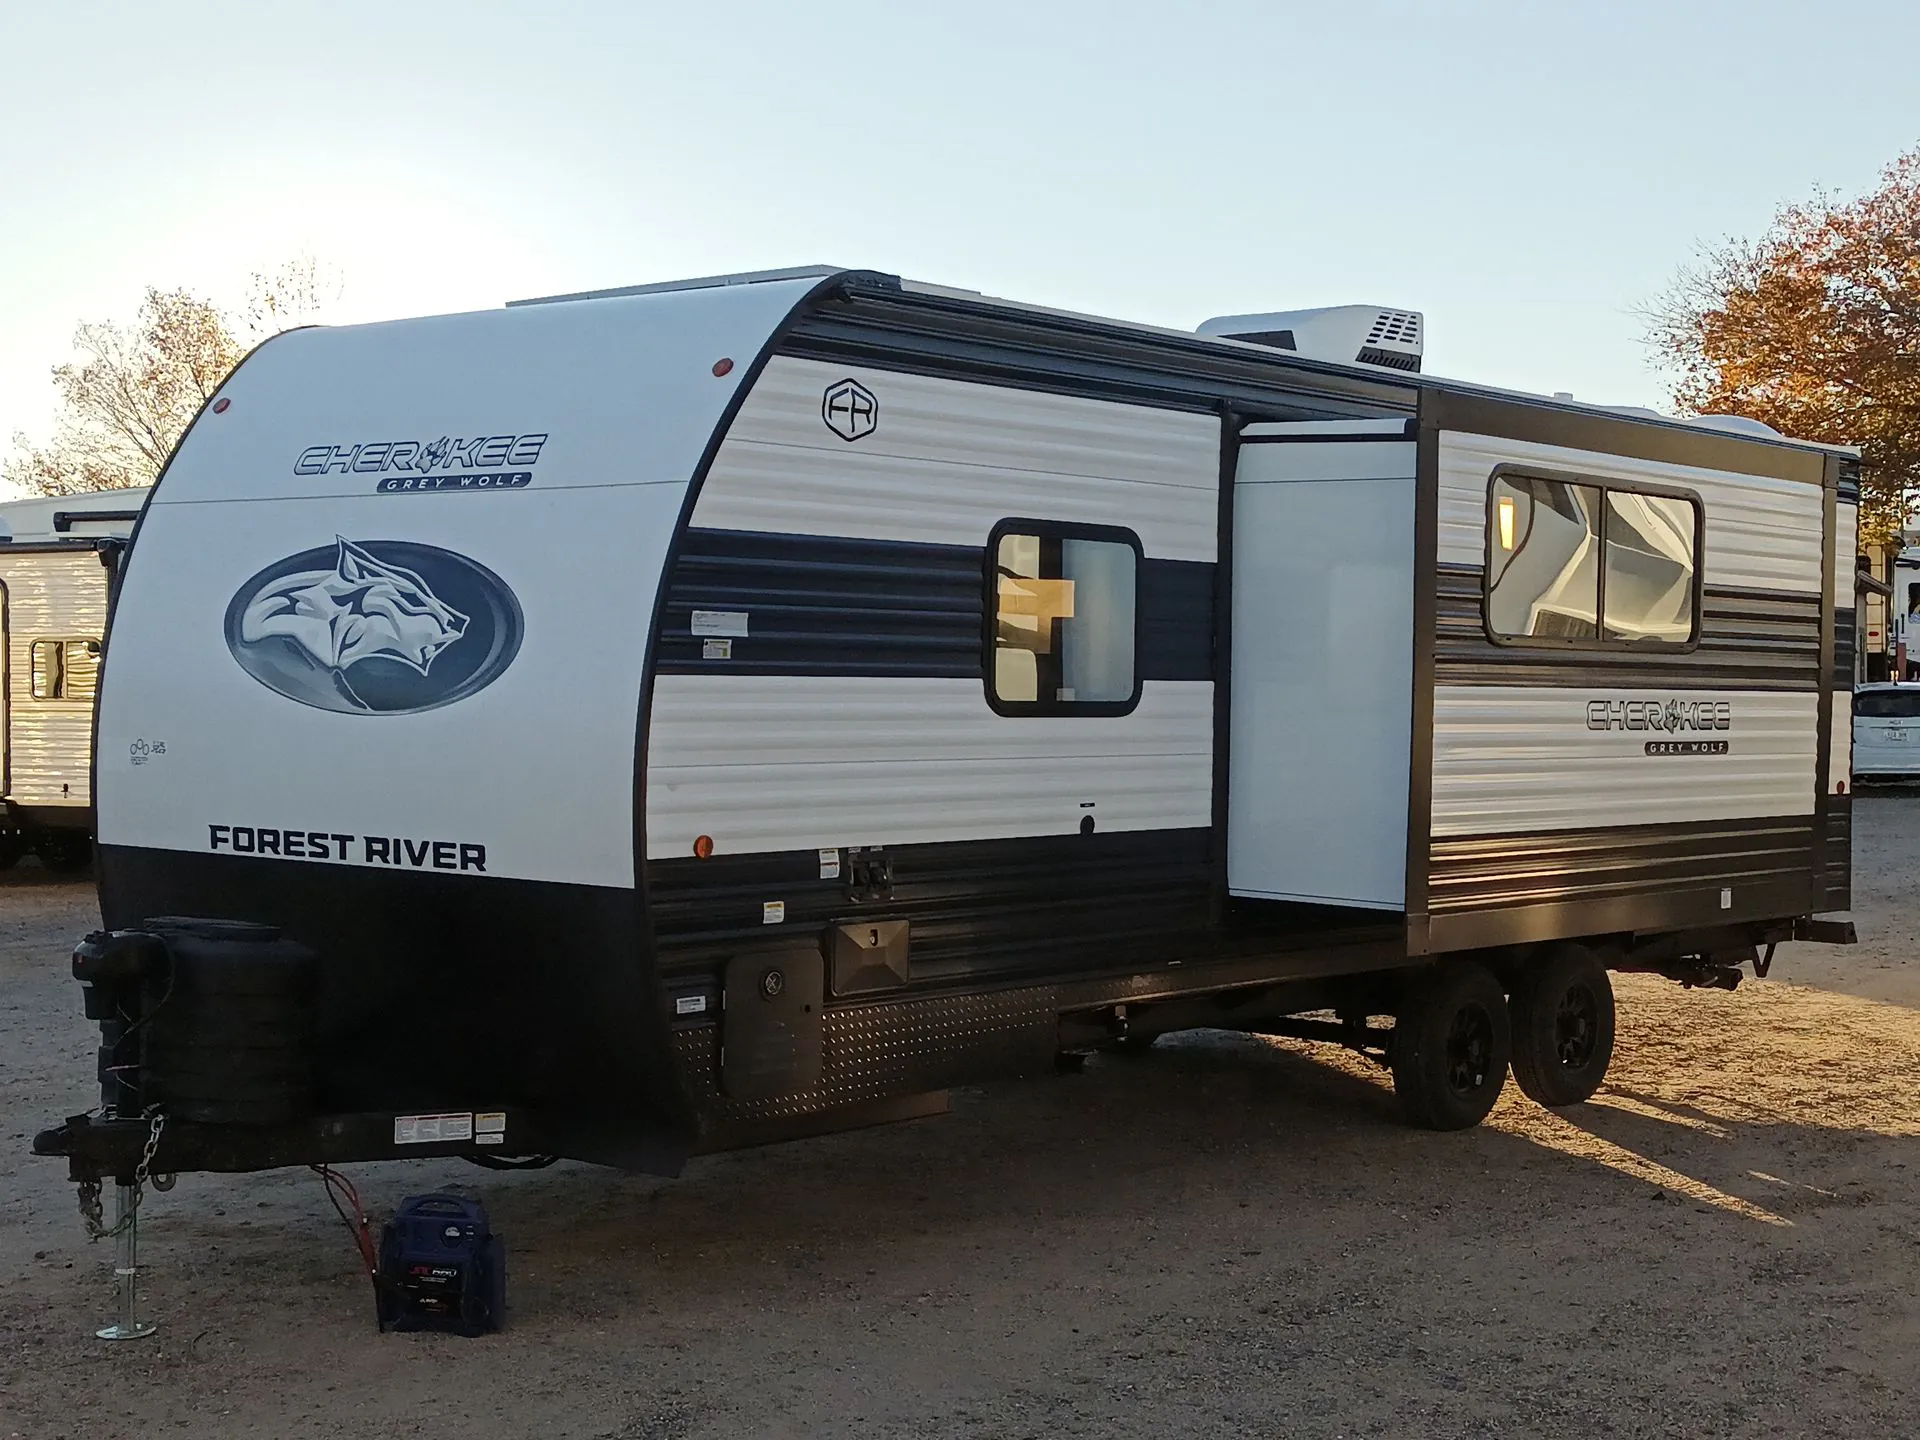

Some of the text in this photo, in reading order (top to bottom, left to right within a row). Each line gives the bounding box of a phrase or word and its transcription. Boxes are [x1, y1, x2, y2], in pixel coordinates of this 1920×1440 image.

[386, 474, 523, 491] GREY WOLF
[1650, 742, 1725, 753] GREY WOLF
[208, 824, 487, 872] FOREST RIVER
